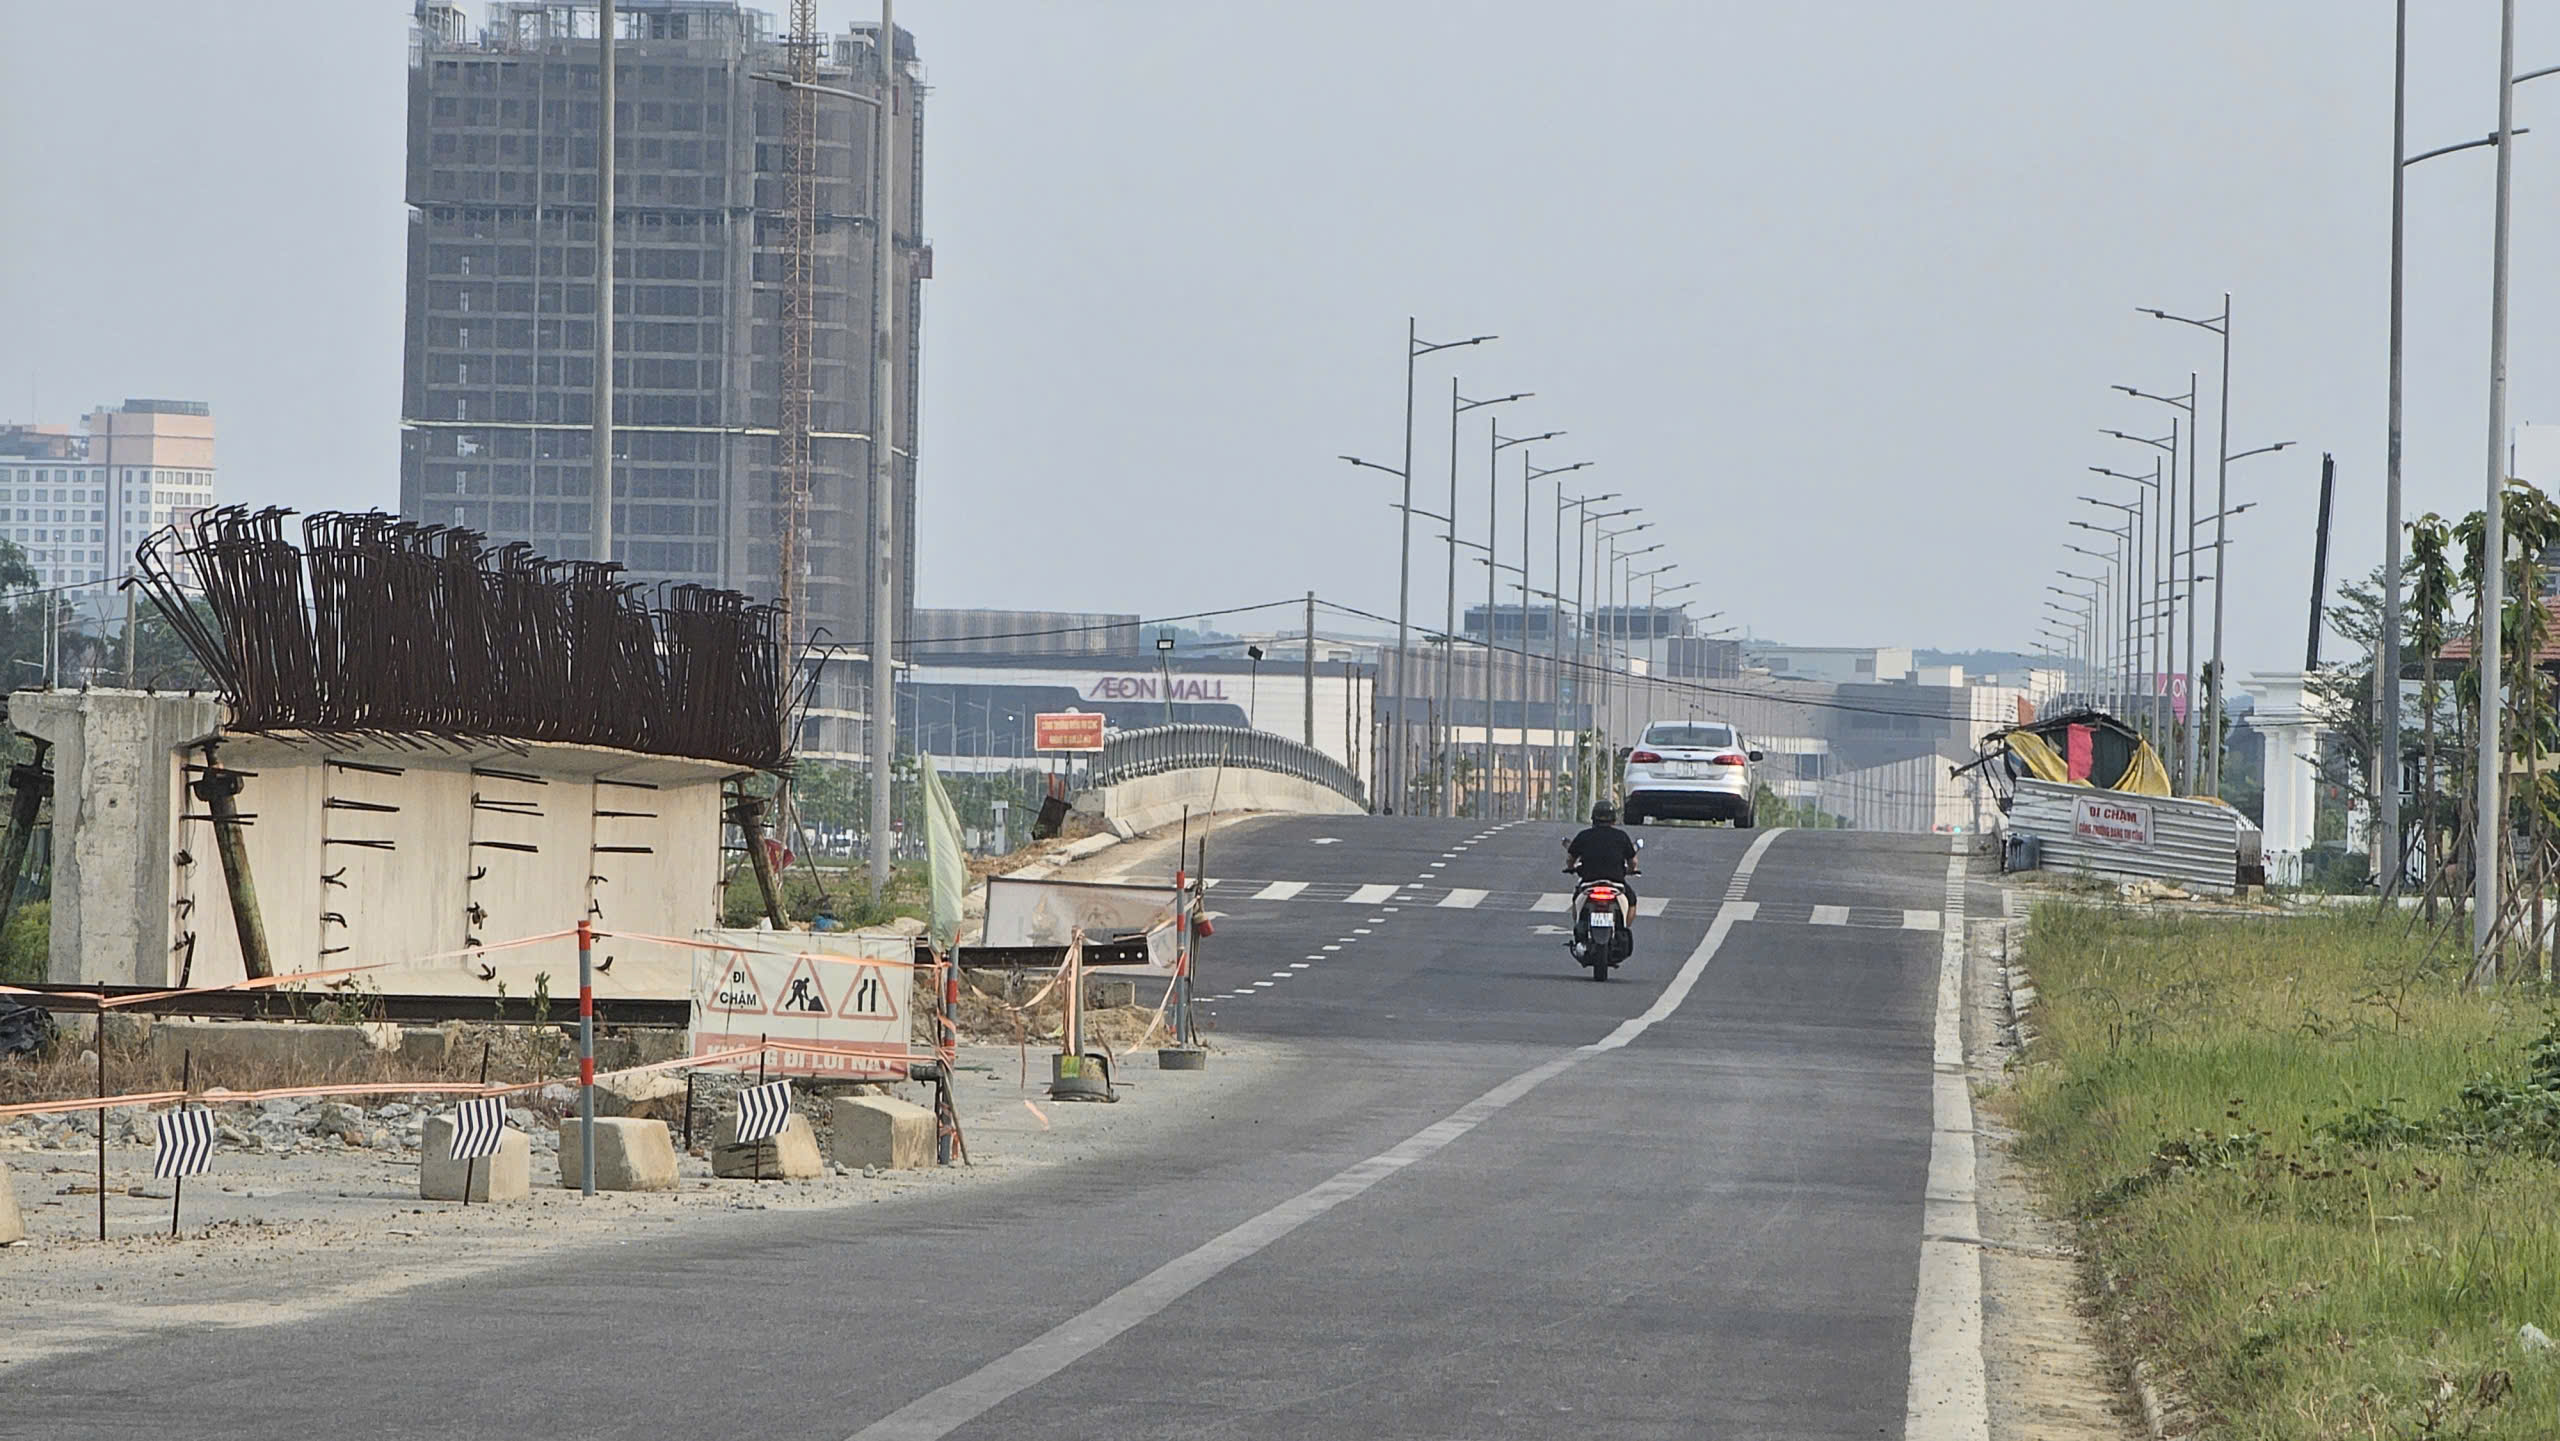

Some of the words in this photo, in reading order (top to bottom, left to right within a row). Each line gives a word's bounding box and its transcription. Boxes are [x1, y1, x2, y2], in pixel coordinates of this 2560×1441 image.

[1164, 679, 1229, 701] MALL
[733, 971, 745, 984] ĐI
[720, 990, 757, 1009] CHẬM
